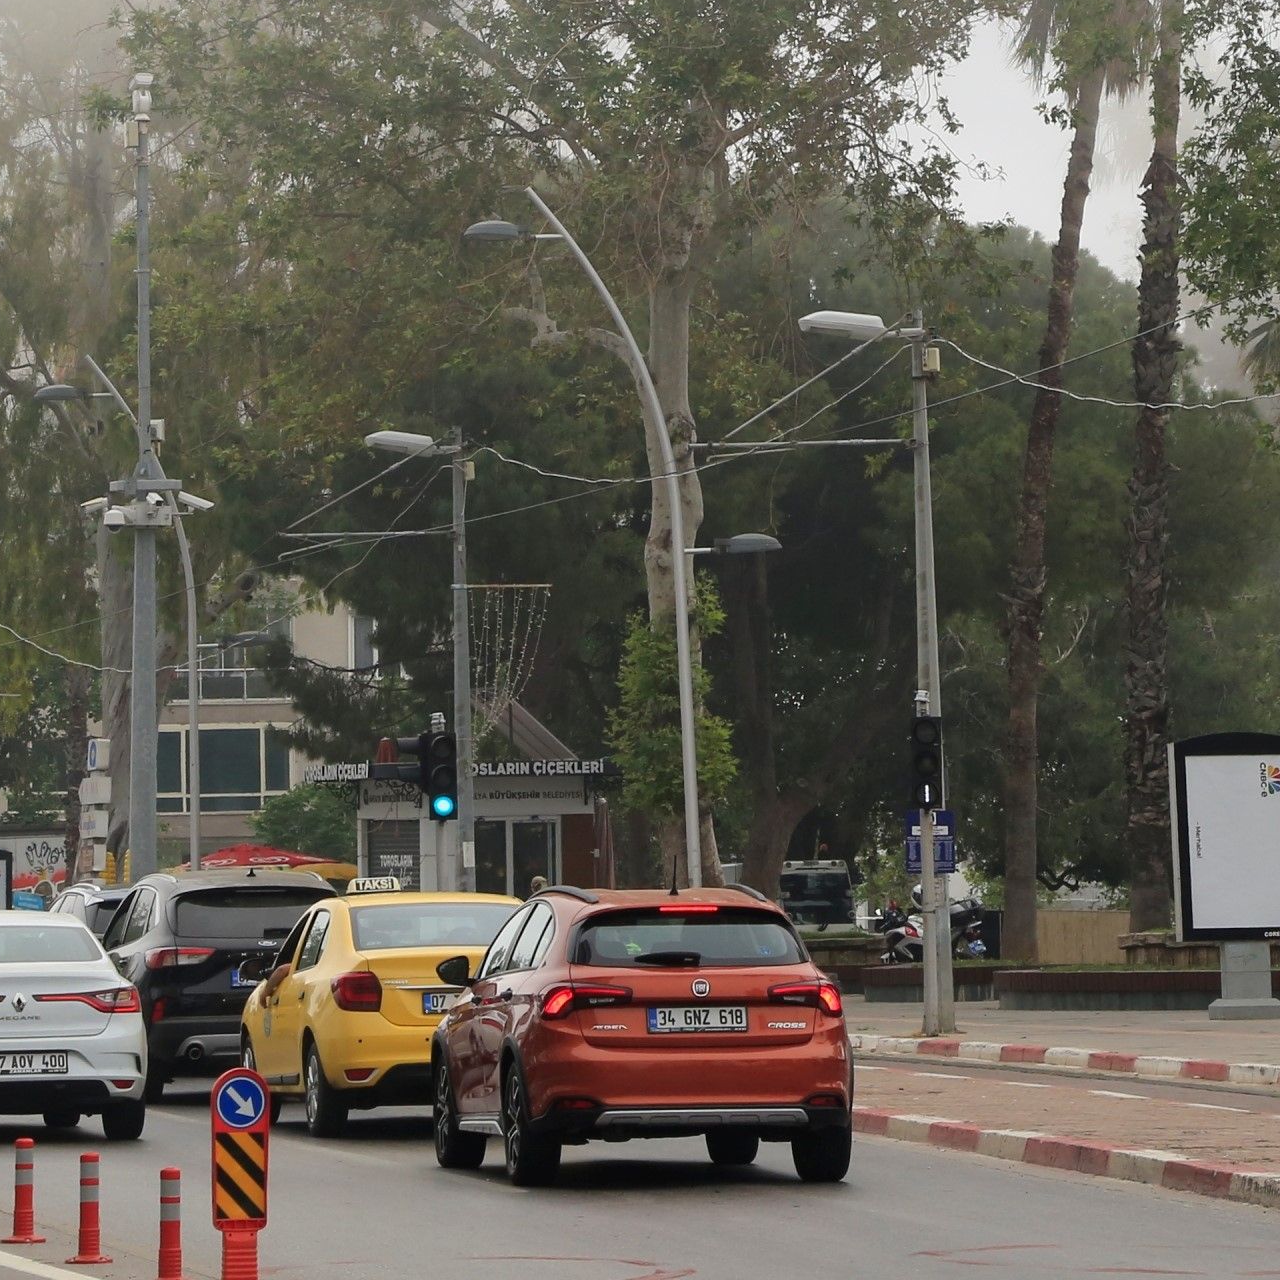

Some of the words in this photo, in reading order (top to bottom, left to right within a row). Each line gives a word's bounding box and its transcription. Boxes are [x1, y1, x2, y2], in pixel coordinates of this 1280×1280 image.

[470, 761, 530, 776] OSLARIN
[533, 759, 604, 776] ÇİÇEKLERİ
[1259, 762, 1268, 798] CNBC-e
[431, 995, 446, 1008] 07
[658, 1009, 676, 1026] 34
[683, 1010, 710, 1025] GNZ
[719, 1009, 743, 1025] 618
[11, 1055, 34, 1069] AOV
[42, 1054, 65, 1068] 400
